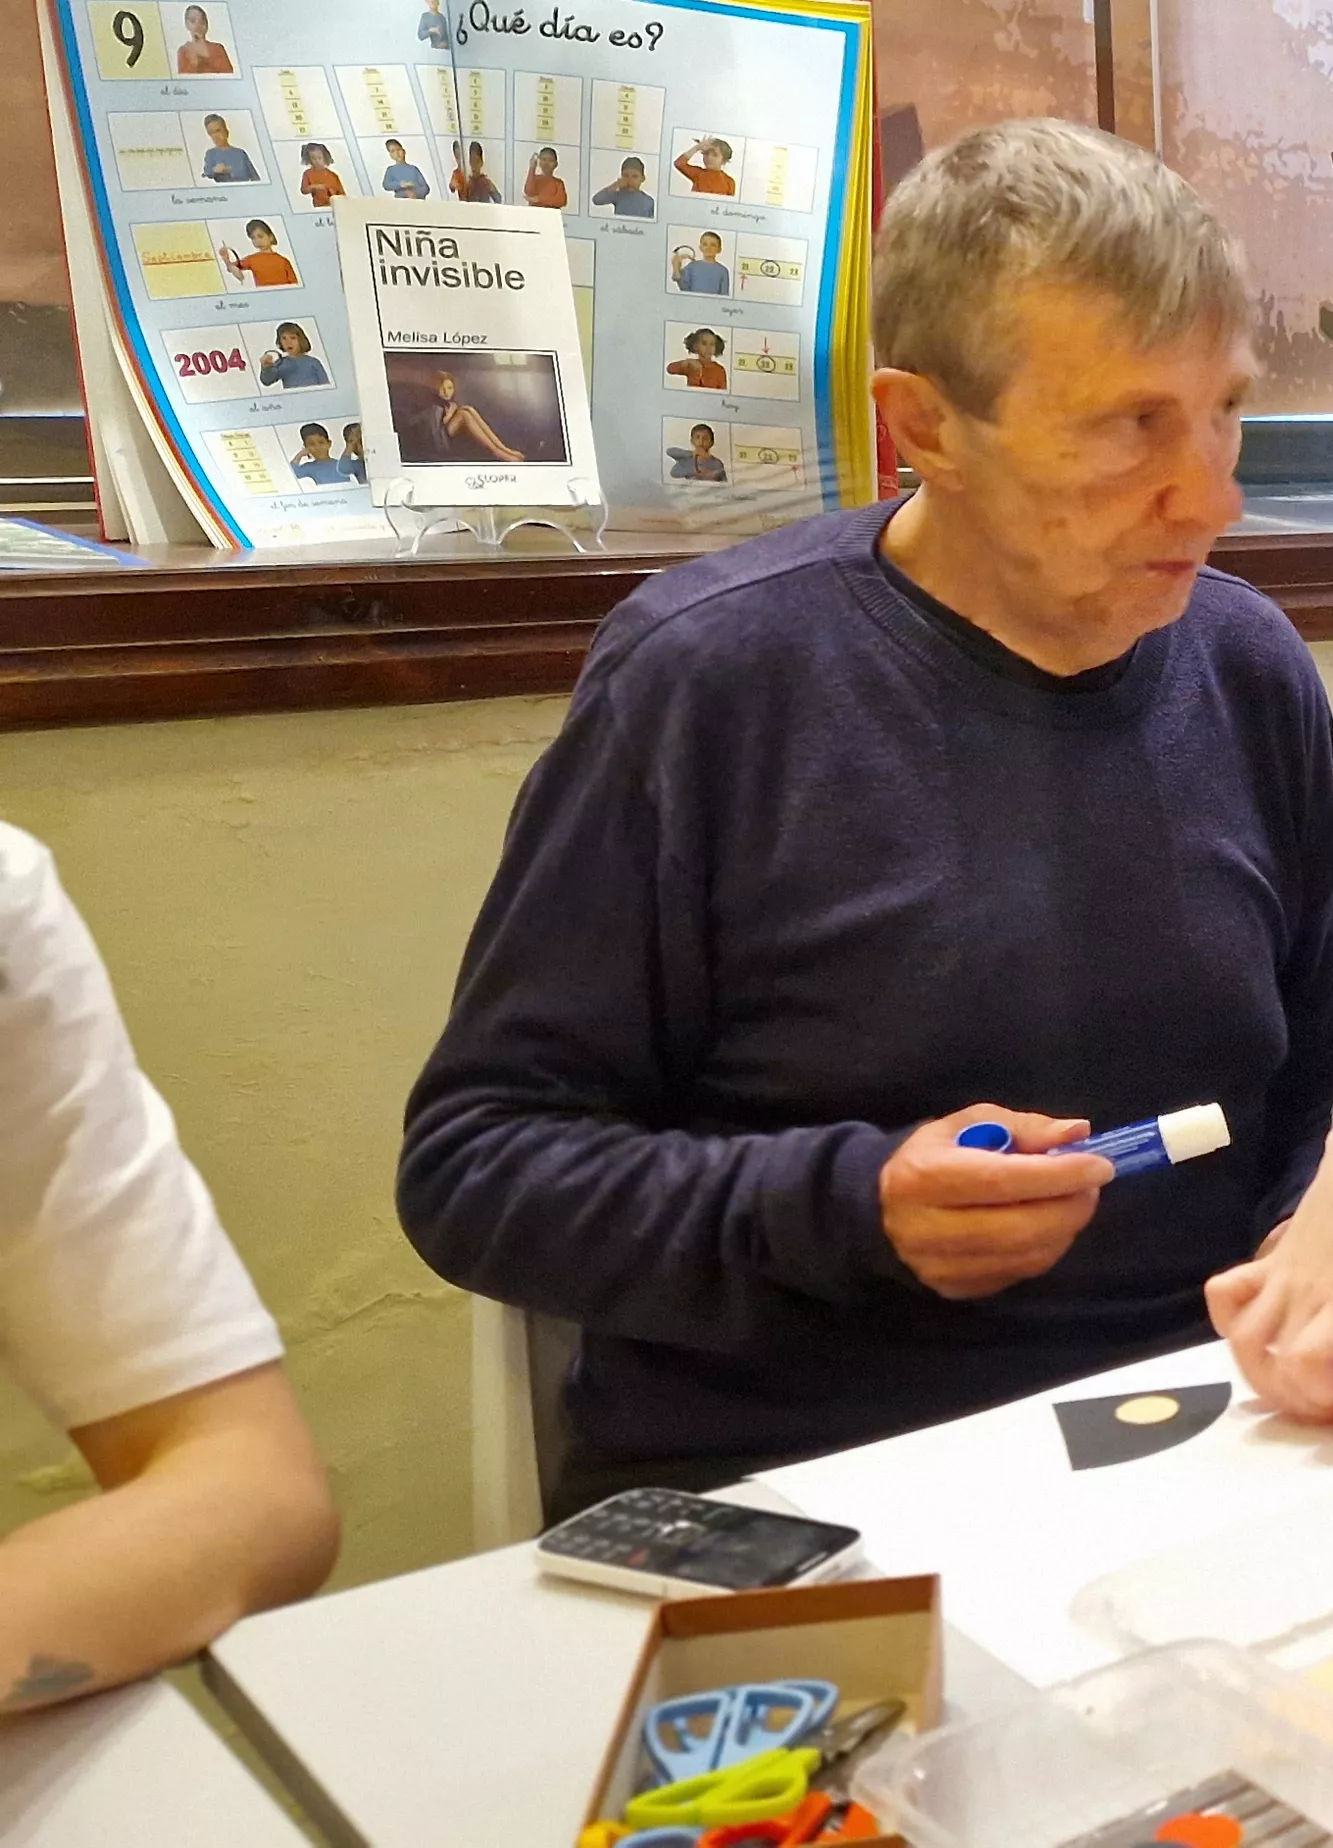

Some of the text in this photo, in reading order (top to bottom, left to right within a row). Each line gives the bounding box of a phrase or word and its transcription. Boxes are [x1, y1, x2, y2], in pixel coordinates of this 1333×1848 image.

[113, 10, 144, 68] 9
[456, 0, 664, 51] ¿Qué día es?
[375, 229, 460, 259] Niña
[379, 259, 526, 290] invisible
[387, 331, 488, 345] Melisa López
[174, 348, 246, 377] 2004
